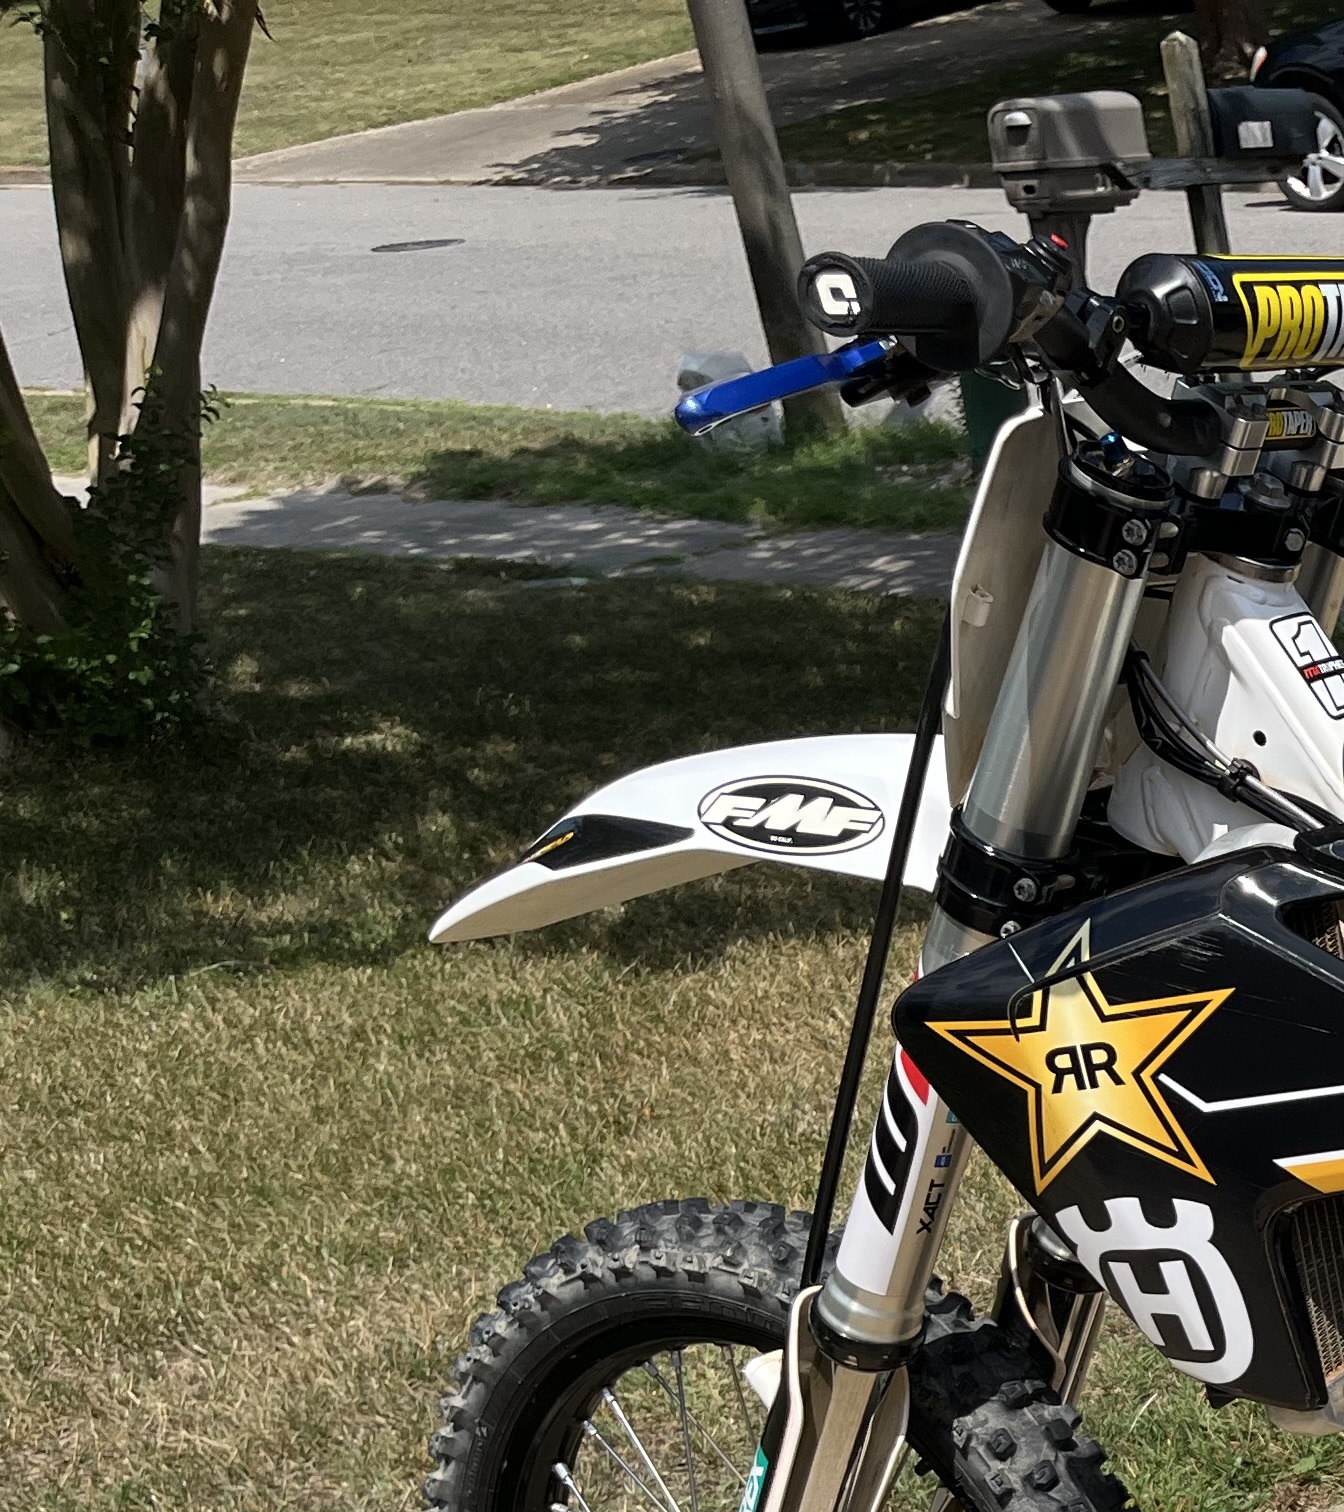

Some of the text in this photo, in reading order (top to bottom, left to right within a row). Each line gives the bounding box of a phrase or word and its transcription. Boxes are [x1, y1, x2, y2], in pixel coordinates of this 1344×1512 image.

[1268, 411, 1316, 437] ROTAPER
[700, 793, 882, 837] FMF
[916, 1178, 946, 1235] XACT
